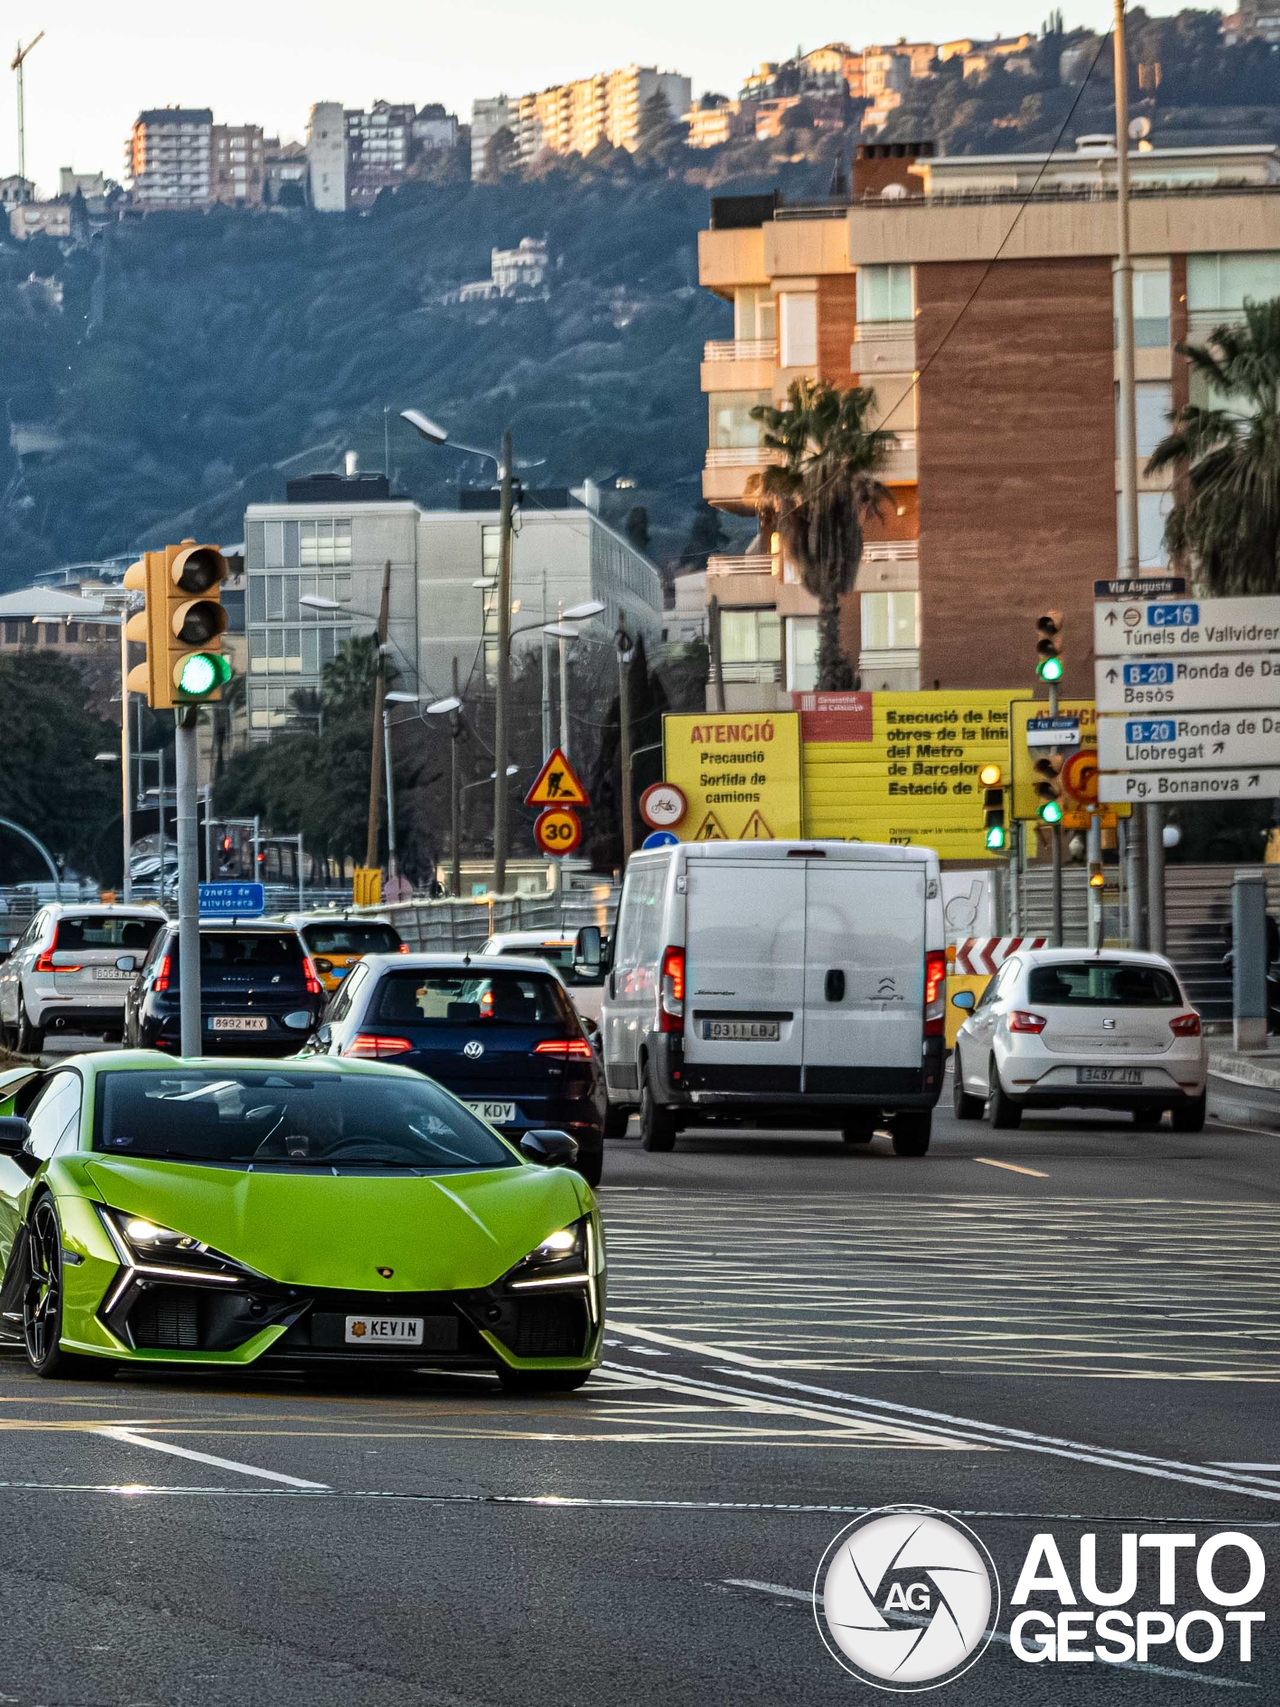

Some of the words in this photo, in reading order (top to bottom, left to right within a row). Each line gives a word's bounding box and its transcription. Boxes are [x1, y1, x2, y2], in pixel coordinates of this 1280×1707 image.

[1108, 581, 1125, 593] Via
[1128, 580, 1172, 595] Augusta
[1153, 606, 1193, 625] C-16
[1123, 628, 1176, 645] Túnels
[1180, 627, 1200, 644] de
[1129, 665, 1167, 684] B-20
[1177, 662, 1229, 680] Ronda
[1234, 661, 1255, 678] de
[1124, 687, 1174, 704] Besòs
[886, 710, 958, 724] Execució
[963, 710, 983, 724] de
[988, 709, 1009, 723] les
[690, 719, 774, 744] ATENCIÓ
[887, 728, 932, 741] obres
[937, 728, 956, 740] de
[962, 728, 976, 740] la
[1131, 724, 1170, 741] B-20
[1178, 720, 1231, 737] Ronda
[1236, 719, 1256, 735] de
[700, 751, 765, 764] Precaució
[886, 745, 911, 758] del
[916, 744, 964, 758] Metro
[1125, 743, 1205, 763] Llobregat
[888, 763, 907, 776] de
[700, 773, 746, 787] Sortida
[750, 773, 767, 786] de
[1126, 778, 1152, 798] Pg.
[1158, 777, 1239, 794] Bonanova
[888, 782, 948, 796] Estació
[952, 781, 972, 795] de
[705, 791, 761, 804] camions
[545, 824, 572, 841] 30
[215, 1017, 241, 1029] 8992
[244, 1017, 265, 1029] MXX
[713, 1022, 746, 1037] 0311
[483, 1104, 512, 1118] KDV
[370, 1320, 417, 1337] KEVIN
